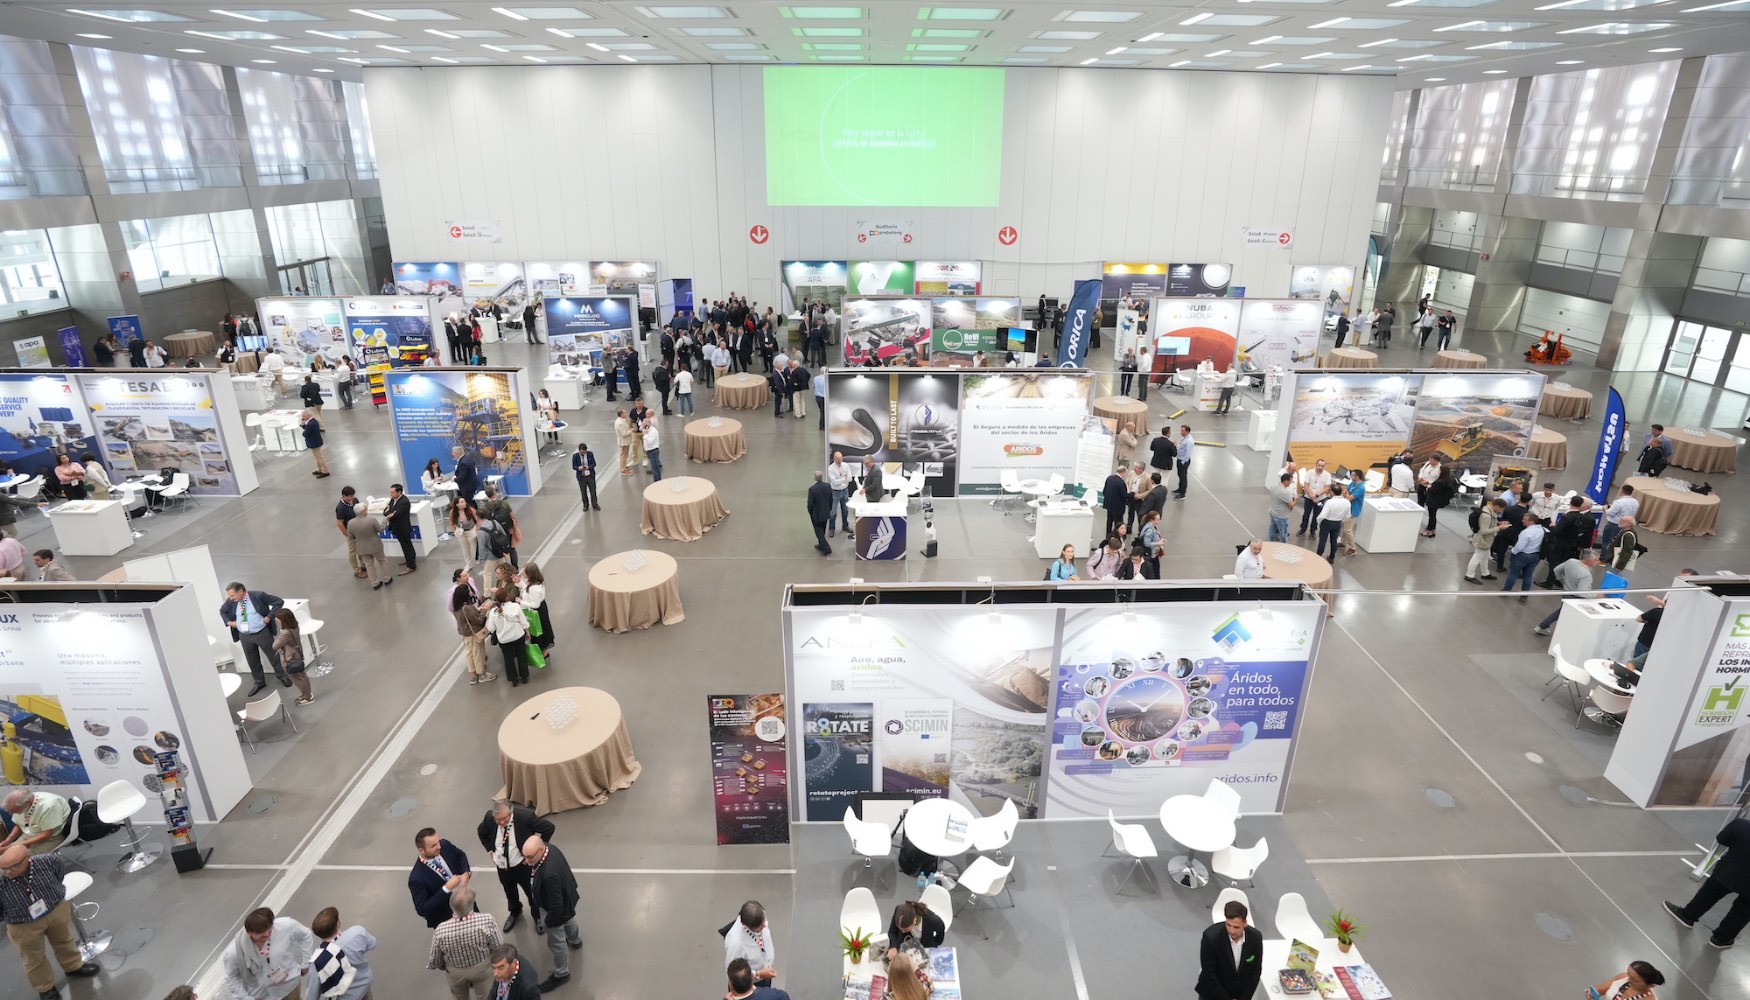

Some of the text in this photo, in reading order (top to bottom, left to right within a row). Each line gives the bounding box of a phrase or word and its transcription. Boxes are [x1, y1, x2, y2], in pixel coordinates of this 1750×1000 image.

[1068, 309, 1087, 360] ORICA
[2, 396, 29, 404] QUALITY
[890, 416, 897, 425] TO
[1725, 641, 1748, 650] MÁS
[851, 656, 906, 664] Aire, agua,
[1230, 670, 1273, 684] Áridos
[1228, 684, 1281, 696] en todo,
[1226, 694, 1295, 709] para todos
[1698, 715, 1733, 723] EXPERT
[904, 719, 948, 732] SCIMIN
[809, 789, 870, 797] rotateproject
